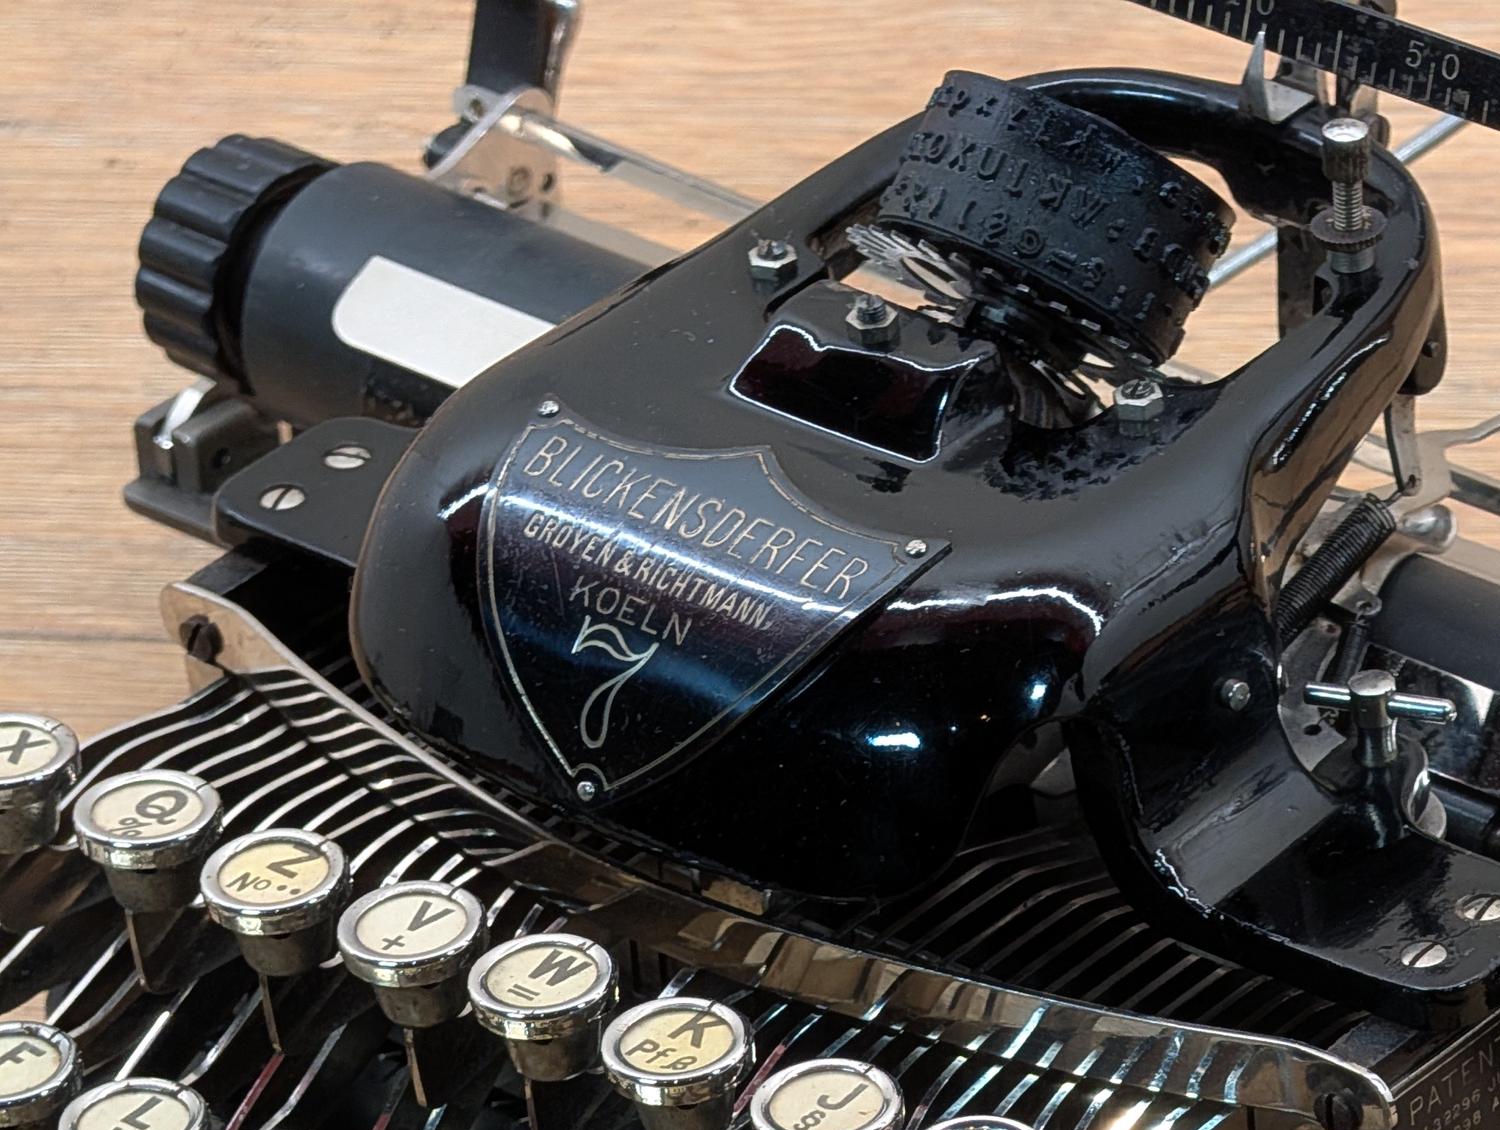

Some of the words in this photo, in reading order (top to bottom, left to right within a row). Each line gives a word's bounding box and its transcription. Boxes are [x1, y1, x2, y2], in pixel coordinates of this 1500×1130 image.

[1405, 40, 1460, 81] 50
[523, 435, 868, 600] BLICKENSDERFER
[524, 509, 616, 567] GROYEN
[569, 576, 693, 646] KOELN
[571, 615, 660, 749] 7
[0, 729, 51, 765] X
[135, 790, 189, 826] Q
[266, 846, 324, 879] Z
[407, 901, 454, 932] V
[528, 949, 592, 986] W
[668, 1012, 728, 1049] K
[0, 1041, 46, 1066] F
[817, 1083, 870, 1110] J
